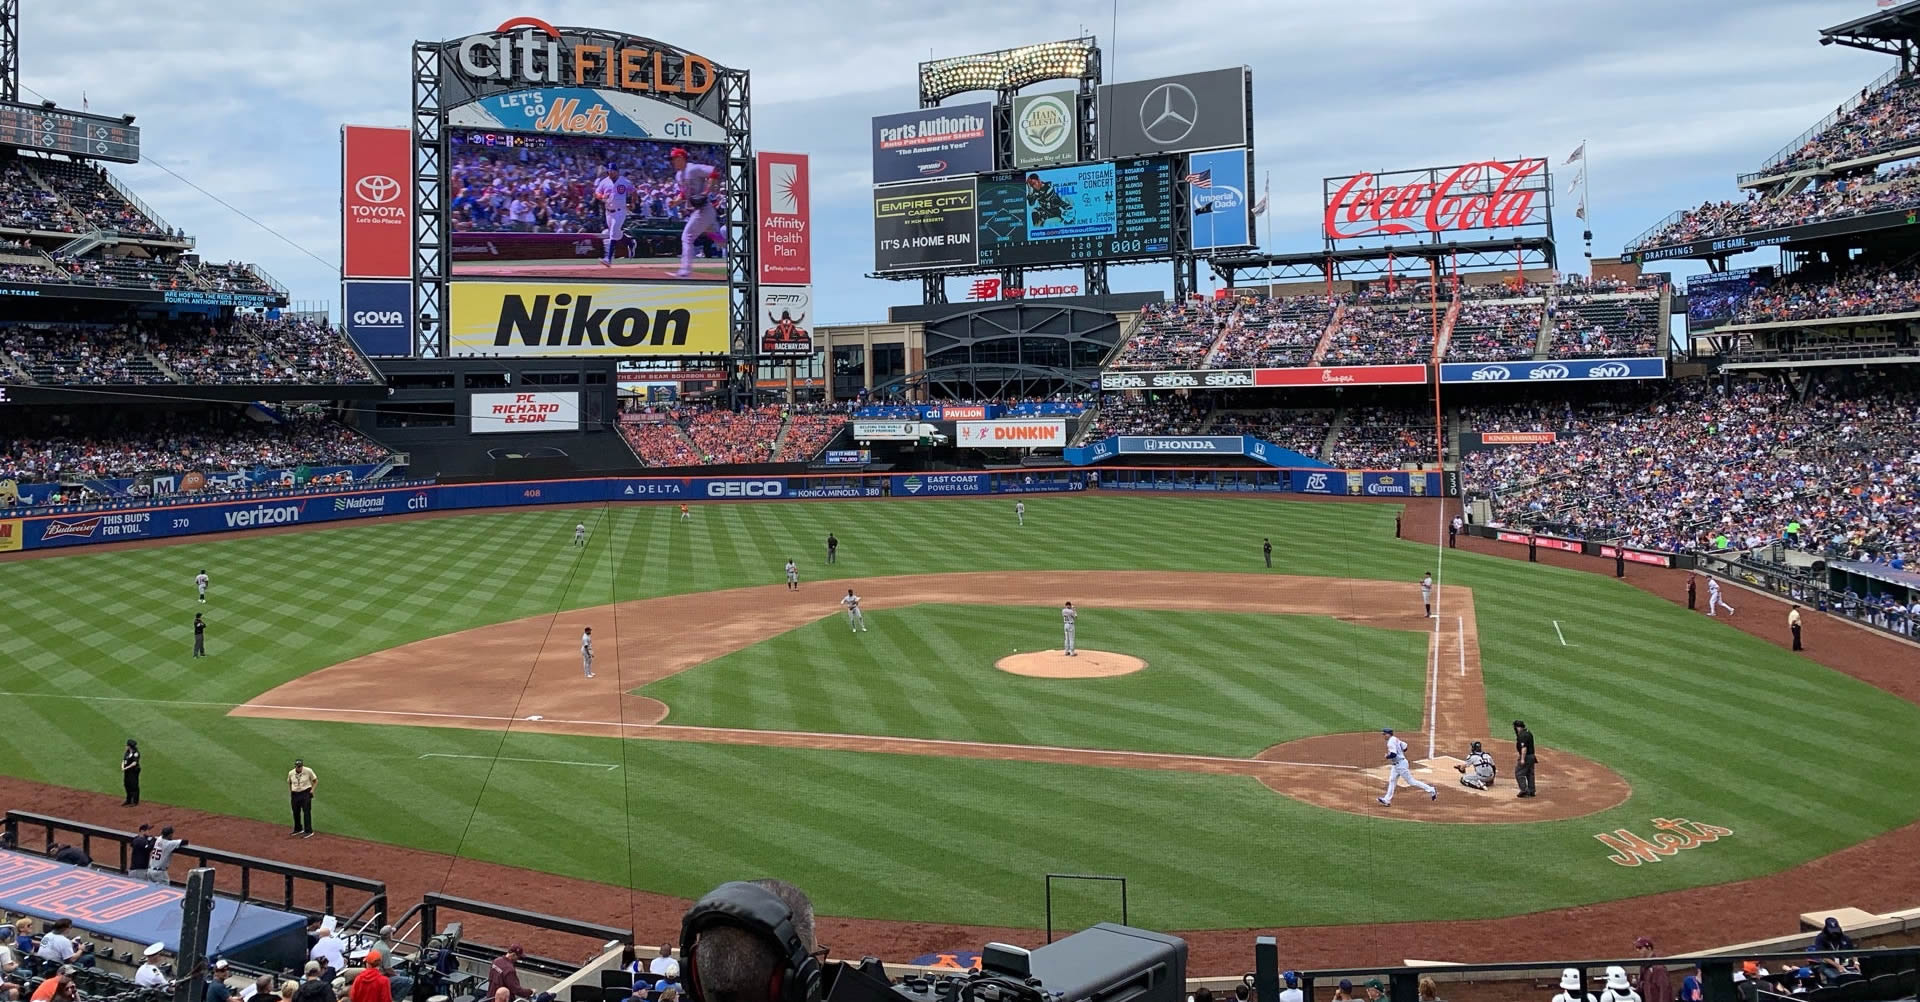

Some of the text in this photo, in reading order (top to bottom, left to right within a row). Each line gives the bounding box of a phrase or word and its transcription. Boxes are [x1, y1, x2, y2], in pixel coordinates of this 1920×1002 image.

[459, 26, 715, 95] citi FIELD
[500, 91, 544, 109] LET'S
[524, 104, 546, 117] GO
[535, 98, 609, 133] Mets
[1032, 110, 1057, 120] HAIN
[41, 111, 83, 123] LEAGUE
[1021, 115, 1067, 129] CELESTIAL
[664, 119, 692, 137] citi
[880, 115, 984, 142] Parts Authority
[884, 132, 981, 148] Auto Parts Super Stores
[913, 145, 940, 154] Answer
[1134, 159, 1150, 167] METS
[1078, 169, 1114, 181] POSTGAME
[1083, 178, 1114, 189] CONCERT
[1056, 186, 1078, 195] HILL
[1200, 192, 1234, 202] Imperial
[881, 199, 933, 212] EMPIRE
[1214, 200, 1237, 208] Dade
[351, 206, 406, 218] TOYOTA
[908, 208, 940, 216] CASINO
[765, 217, 805, 232] Affinity
[768, 231, 803, 243] Health
[881, 233, 971, 251] IT'S A HOME RUN
[774, 244, 797, 257] Plan
[1644, 246, 1694, 260] DRAFTKINGS
[1713, 241, 1726, 250] ONE
[1727, 238, 1749, 249] GAME.
[1003, 284, 1079, 297] new balance
[766, 294, 800, 303] RPM
[353, 311, 404, 325] GOYA
[494, 293, 691, 347] Nikon
[1471, 369, 1504, 381] SNY
[1529, 368, 1562, 380] SNY
[1588, 366, 1623, 378] SNY
[492, 403, 560, 414] RICHARD
[926, 409, 982, 418] citi PAVILION
[504, 414, 547, 424] & SON
[994, 425, 1059, 440] DUNKIN'
[1511, 434, 1548, 442] HAWAIIAN
[1158, 441, 1216, 449] HONDA
[1092, 451, 1112, 461] HONDA
[950, 475, 978, 483] COAST
[638, 484, 681, 494] DELTA
[707, 481, 782, 497] GEICO
[865, 487, 880, 496] 380
[927, 484, 955, 492] POWER
[1069, 482, 1083, 490] 370
[1368, 483, 1404, 495] Corona
[523, 489, 541, 497] 408
[798, 488, 860, 497] KONICA MINOLTA
[345, 496, 385, 509] National
[408, 495, 428, 509] citi
[102, 512, 150, 526] THIS BUD'S
[225, 504, 299, 528] verizon
[49, 521, 97, 535] Budweiser
[102, 523, 142, 536] FOR YOU.
[172, 518, 190, 529] 370
[1593, 818, 1733, 867] Mets
